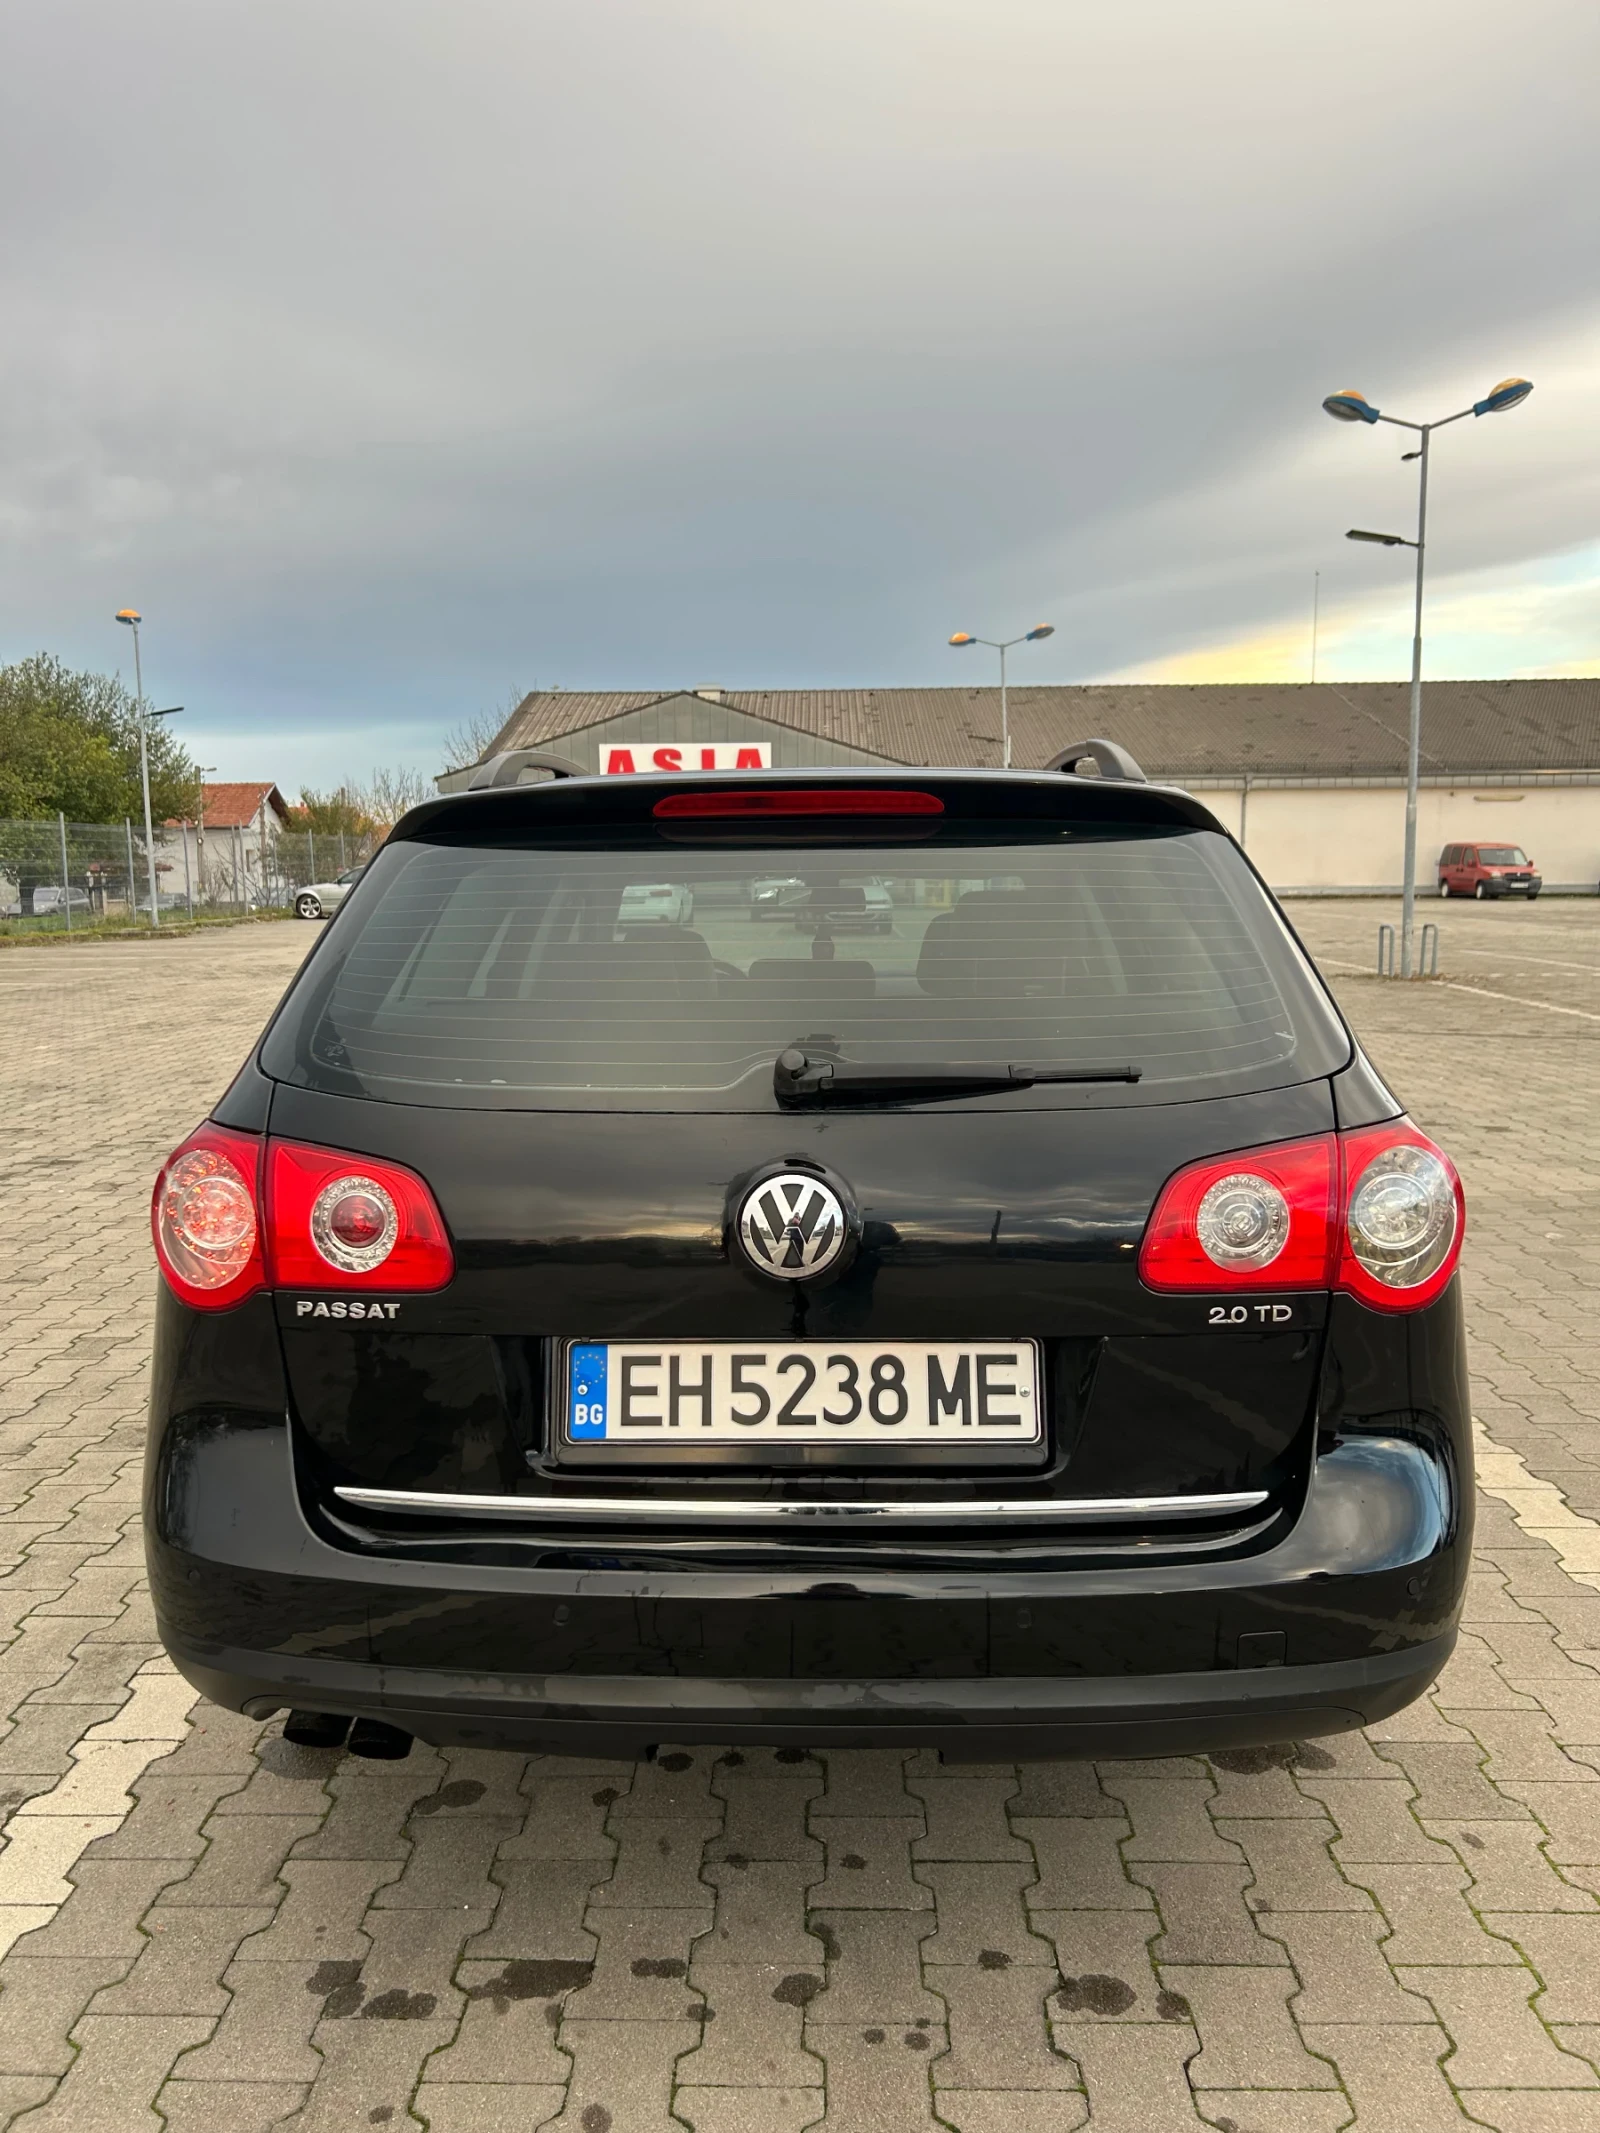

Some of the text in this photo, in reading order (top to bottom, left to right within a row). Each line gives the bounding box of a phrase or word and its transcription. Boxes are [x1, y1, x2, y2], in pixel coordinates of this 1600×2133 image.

[607, 748, 763, 774] ASIA
[297, 1301, 400, 1319] PASSAT
[1208, 1304, 1292, 1324] 2.0 TD
[620, 1354, 1022, 1427] EH 5238 ME
[574, 1403, 604, 1426] BG
